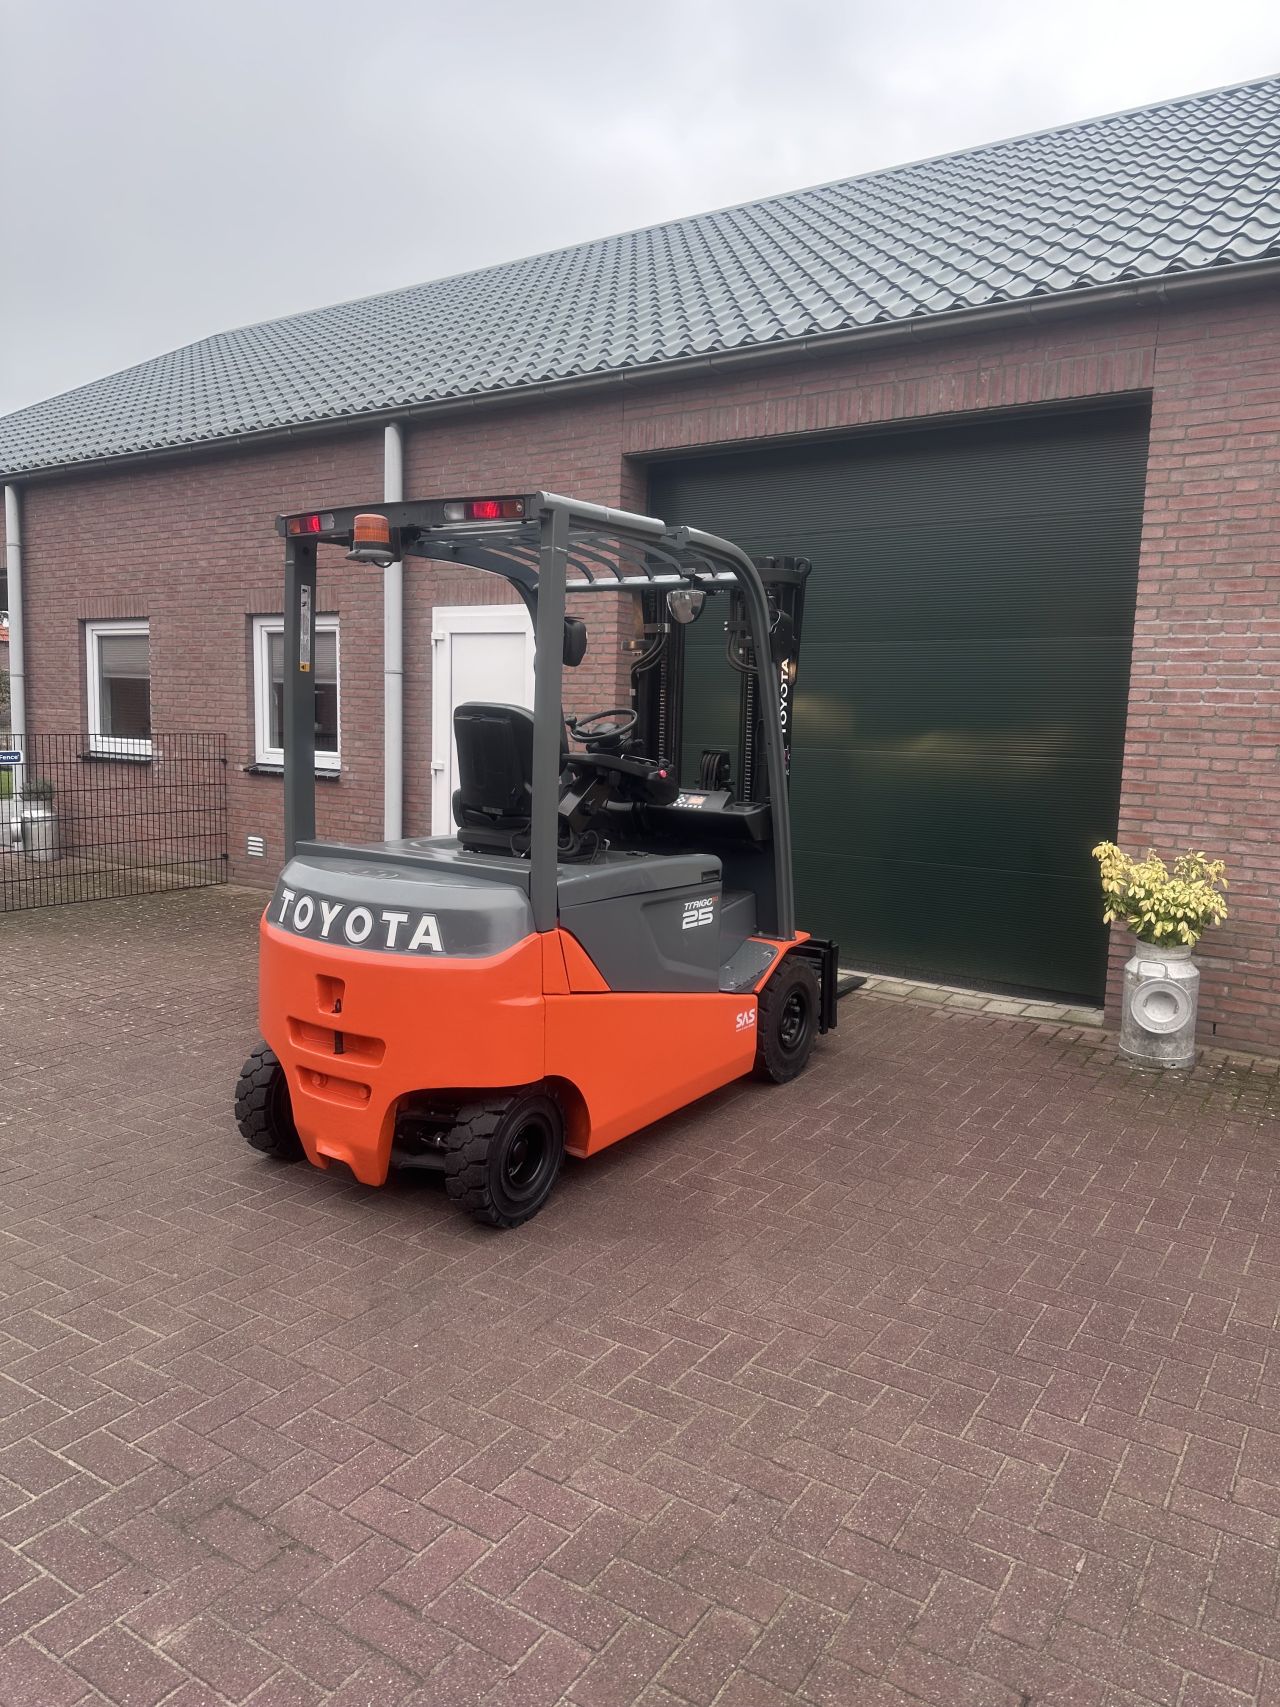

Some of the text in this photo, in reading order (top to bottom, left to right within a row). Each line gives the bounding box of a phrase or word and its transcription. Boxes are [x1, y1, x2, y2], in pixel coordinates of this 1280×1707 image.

[278, 888, 444, 952] TOYOTA
[682, 906, 714, 930] 25
[735, 1008, 756, 1029] SAS
